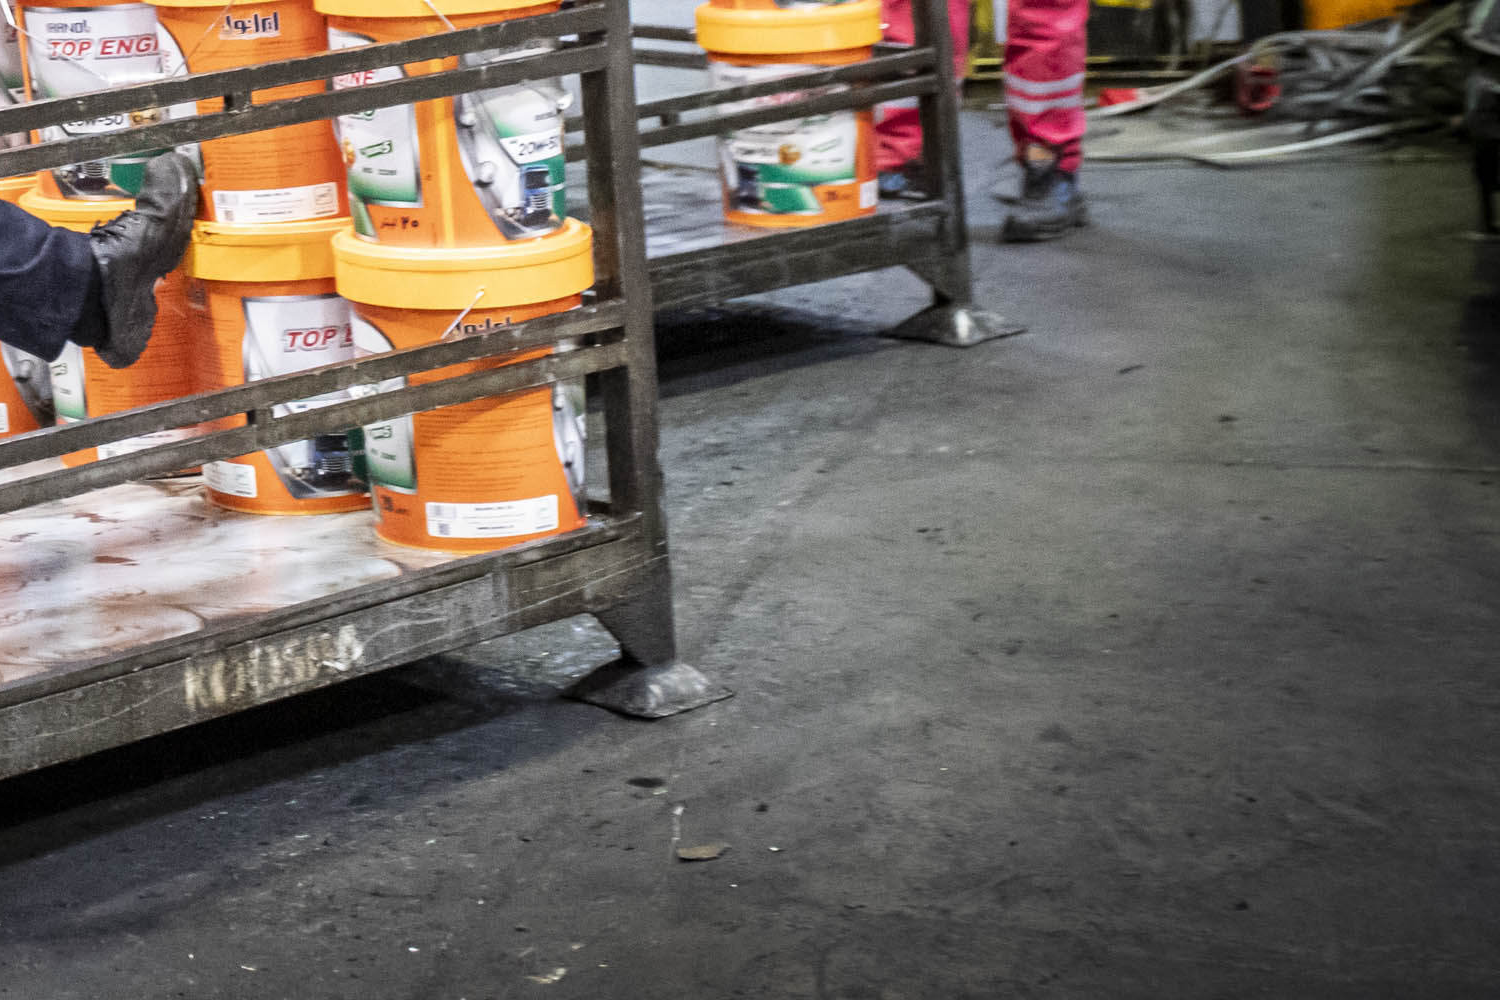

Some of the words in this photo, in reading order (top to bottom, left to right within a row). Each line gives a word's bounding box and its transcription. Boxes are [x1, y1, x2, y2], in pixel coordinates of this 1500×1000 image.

[50, 40, 92, 57] TOP
[100, 35, 159, 56] ENGI
[287, 328, 338, 348] TOP
